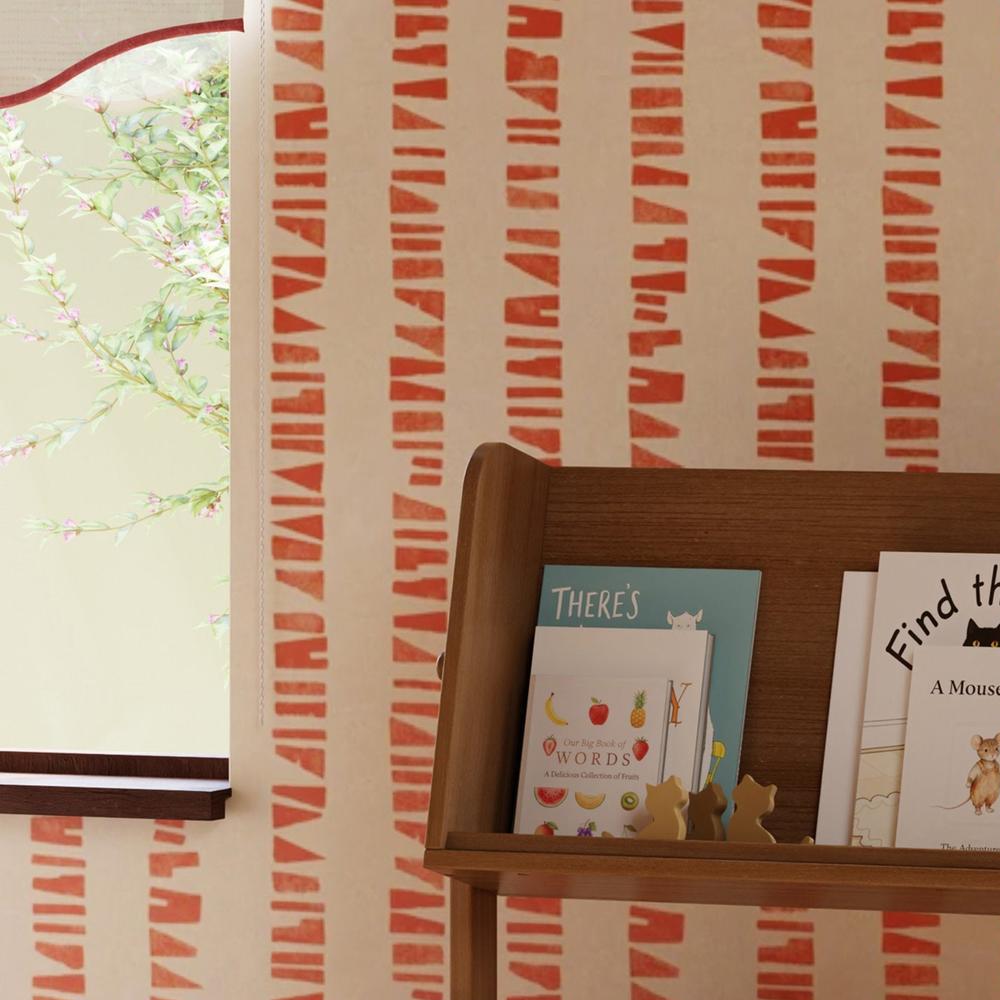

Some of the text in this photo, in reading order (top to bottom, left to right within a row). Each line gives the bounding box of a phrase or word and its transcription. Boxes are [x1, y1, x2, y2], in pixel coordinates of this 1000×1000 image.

[551, 583, 641, 620] THERE'S
[886, 578, 959, 671] Find
[930, 680, 944, 695] A
[556, 751, 632, 767] WORDS
[543, 770, 550, 778] A
[551, 770, 580, 779] Delicious
[580, 771, 613, 780] Collection
[613, 772, 621, 780] of
